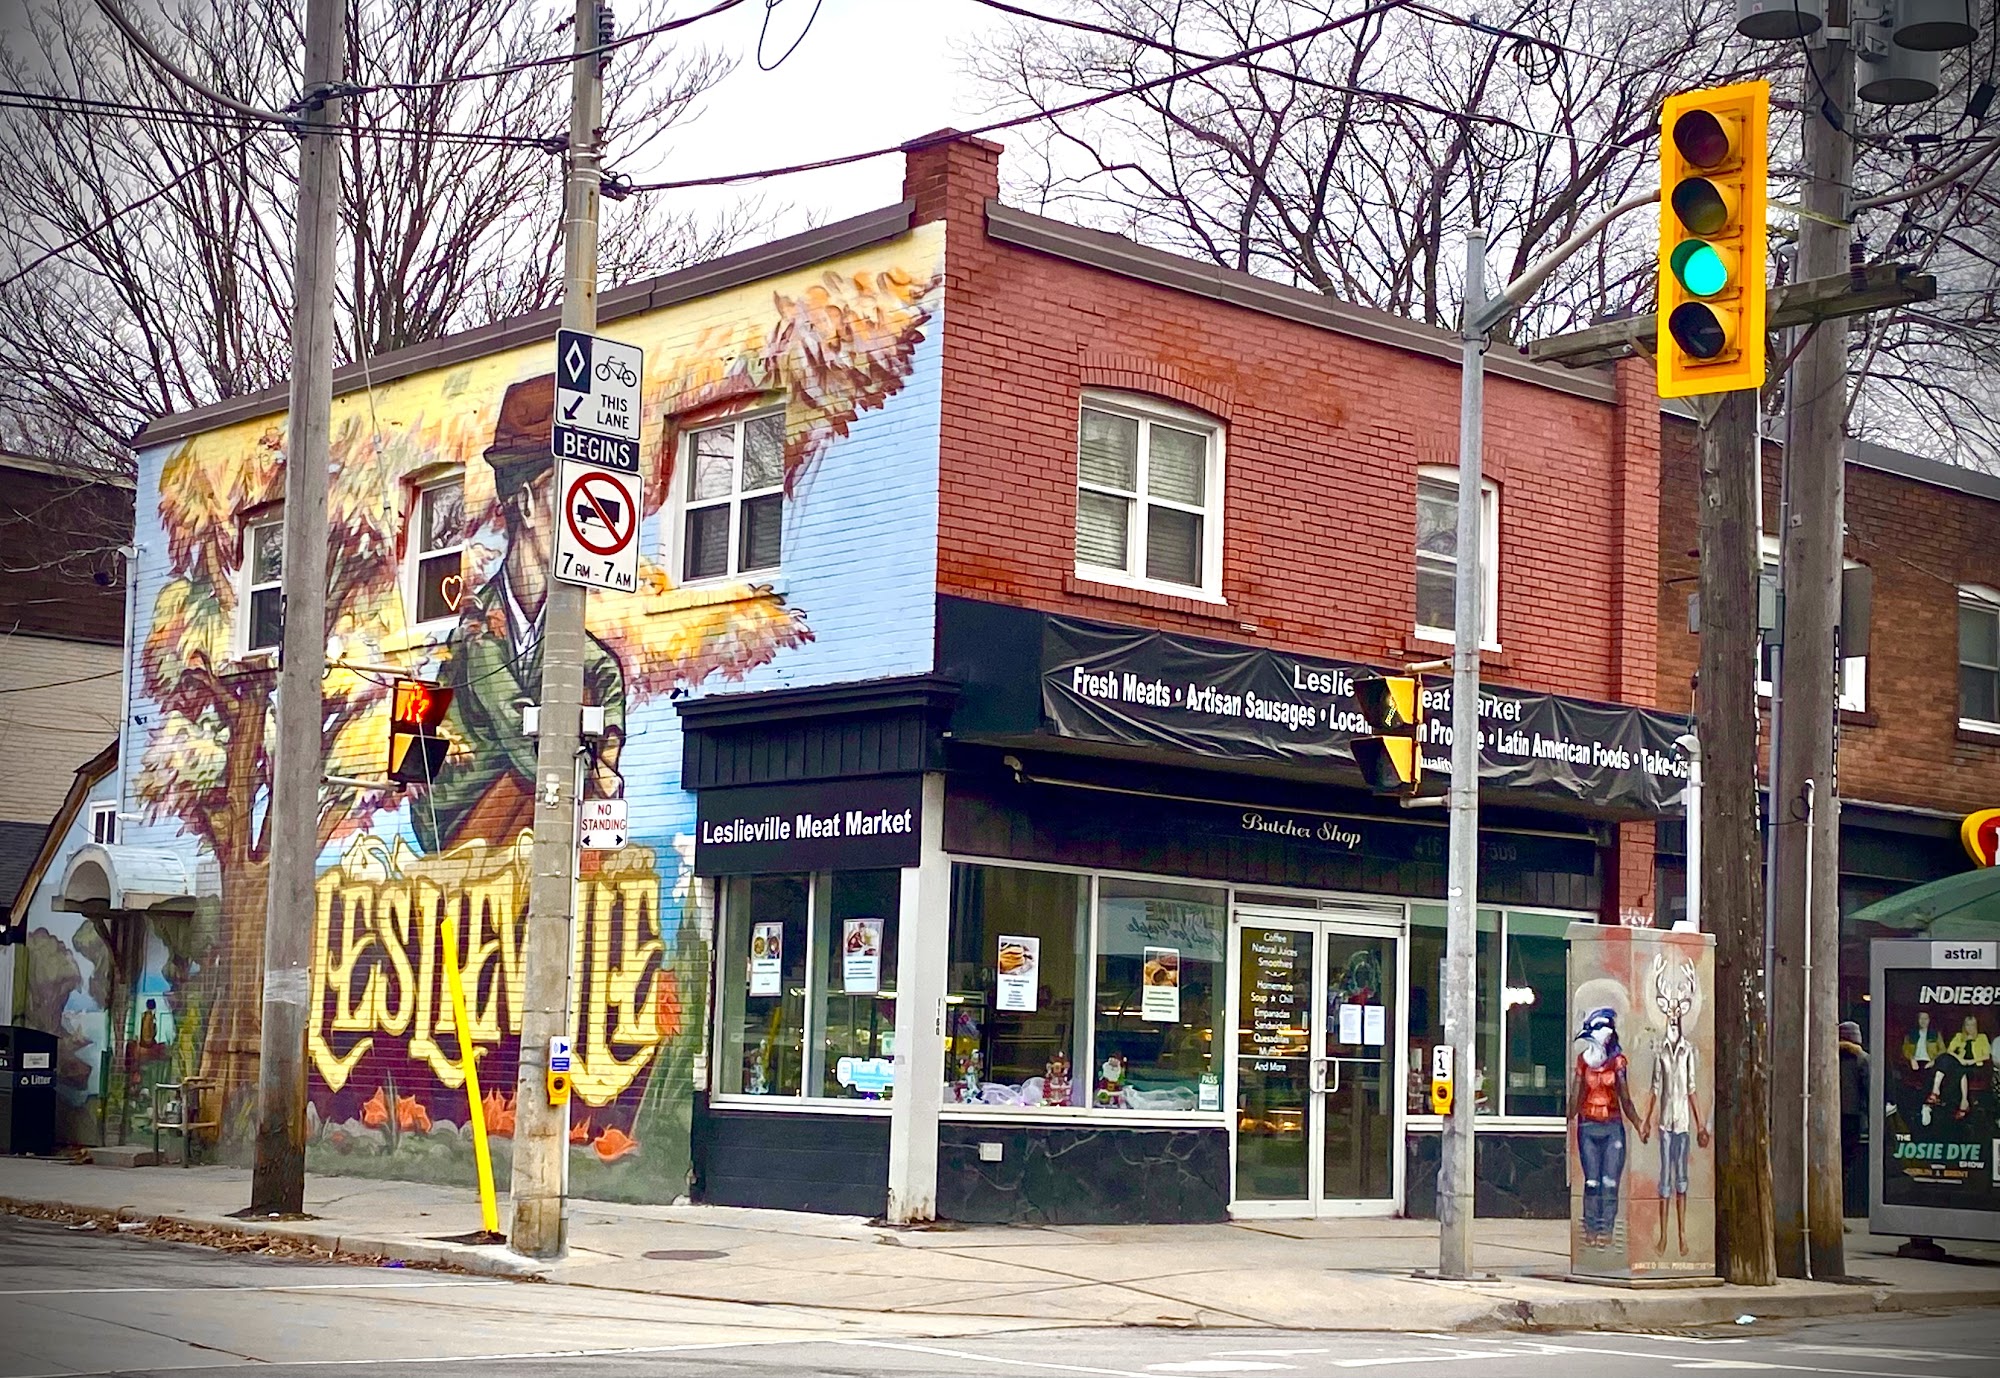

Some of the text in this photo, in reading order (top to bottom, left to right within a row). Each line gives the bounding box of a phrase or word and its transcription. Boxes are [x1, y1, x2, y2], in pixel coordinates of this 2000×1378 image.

[600, 394, 628, 412] THIS
[596, 410, 630, 430] LANE
[563, 434, 631, 467] BEGINS
[562, 552, 574, 577] 7
[603, 561, 614, 583] 7
[616, 573, 631, 588] AM
[1421, 688, 1451, 712] eat
[1477, 694, 1522, 722] arket
[1073, 666, 1119, 700] Fresh
[1123, 673, 1171, 708] Meats
[1186, 683, 1241, 717] Artisan
[1245, 691, 1316, 731] Sausages
[1497, 728, 1529, 757] Latin
[1532, 732, 1590, 765] American
[1593, 743, 1631, 770] Foods
[597, 804, 612, 816] NO
[581, 818, 627, 831] STANDING
[702, 808, 912, 844] Leslieville Meat Market
[1242, 812, 1361, 849] Butcher Shop
[1251, 943, 1298, 957] Natural Juices
[1944, 948, 1982, 960] astral
[1257, 957, 1293, 969] Smoothies
[1256, 980, 1294, 992] Homemade
[1250, 991, 1294, 1004] Soup Chili
[1254, 1007, 1290, 1019] Empanadas
[1254, 1061, 1287, 1072] And More
[31, 1074, 52, 1085] Litter
[1201, 1074, 1218, 1085] PASS
[1896, 1133, 1912, 1142] THE
[1893, 1142, 1981, 1160] JOSIE DYE
